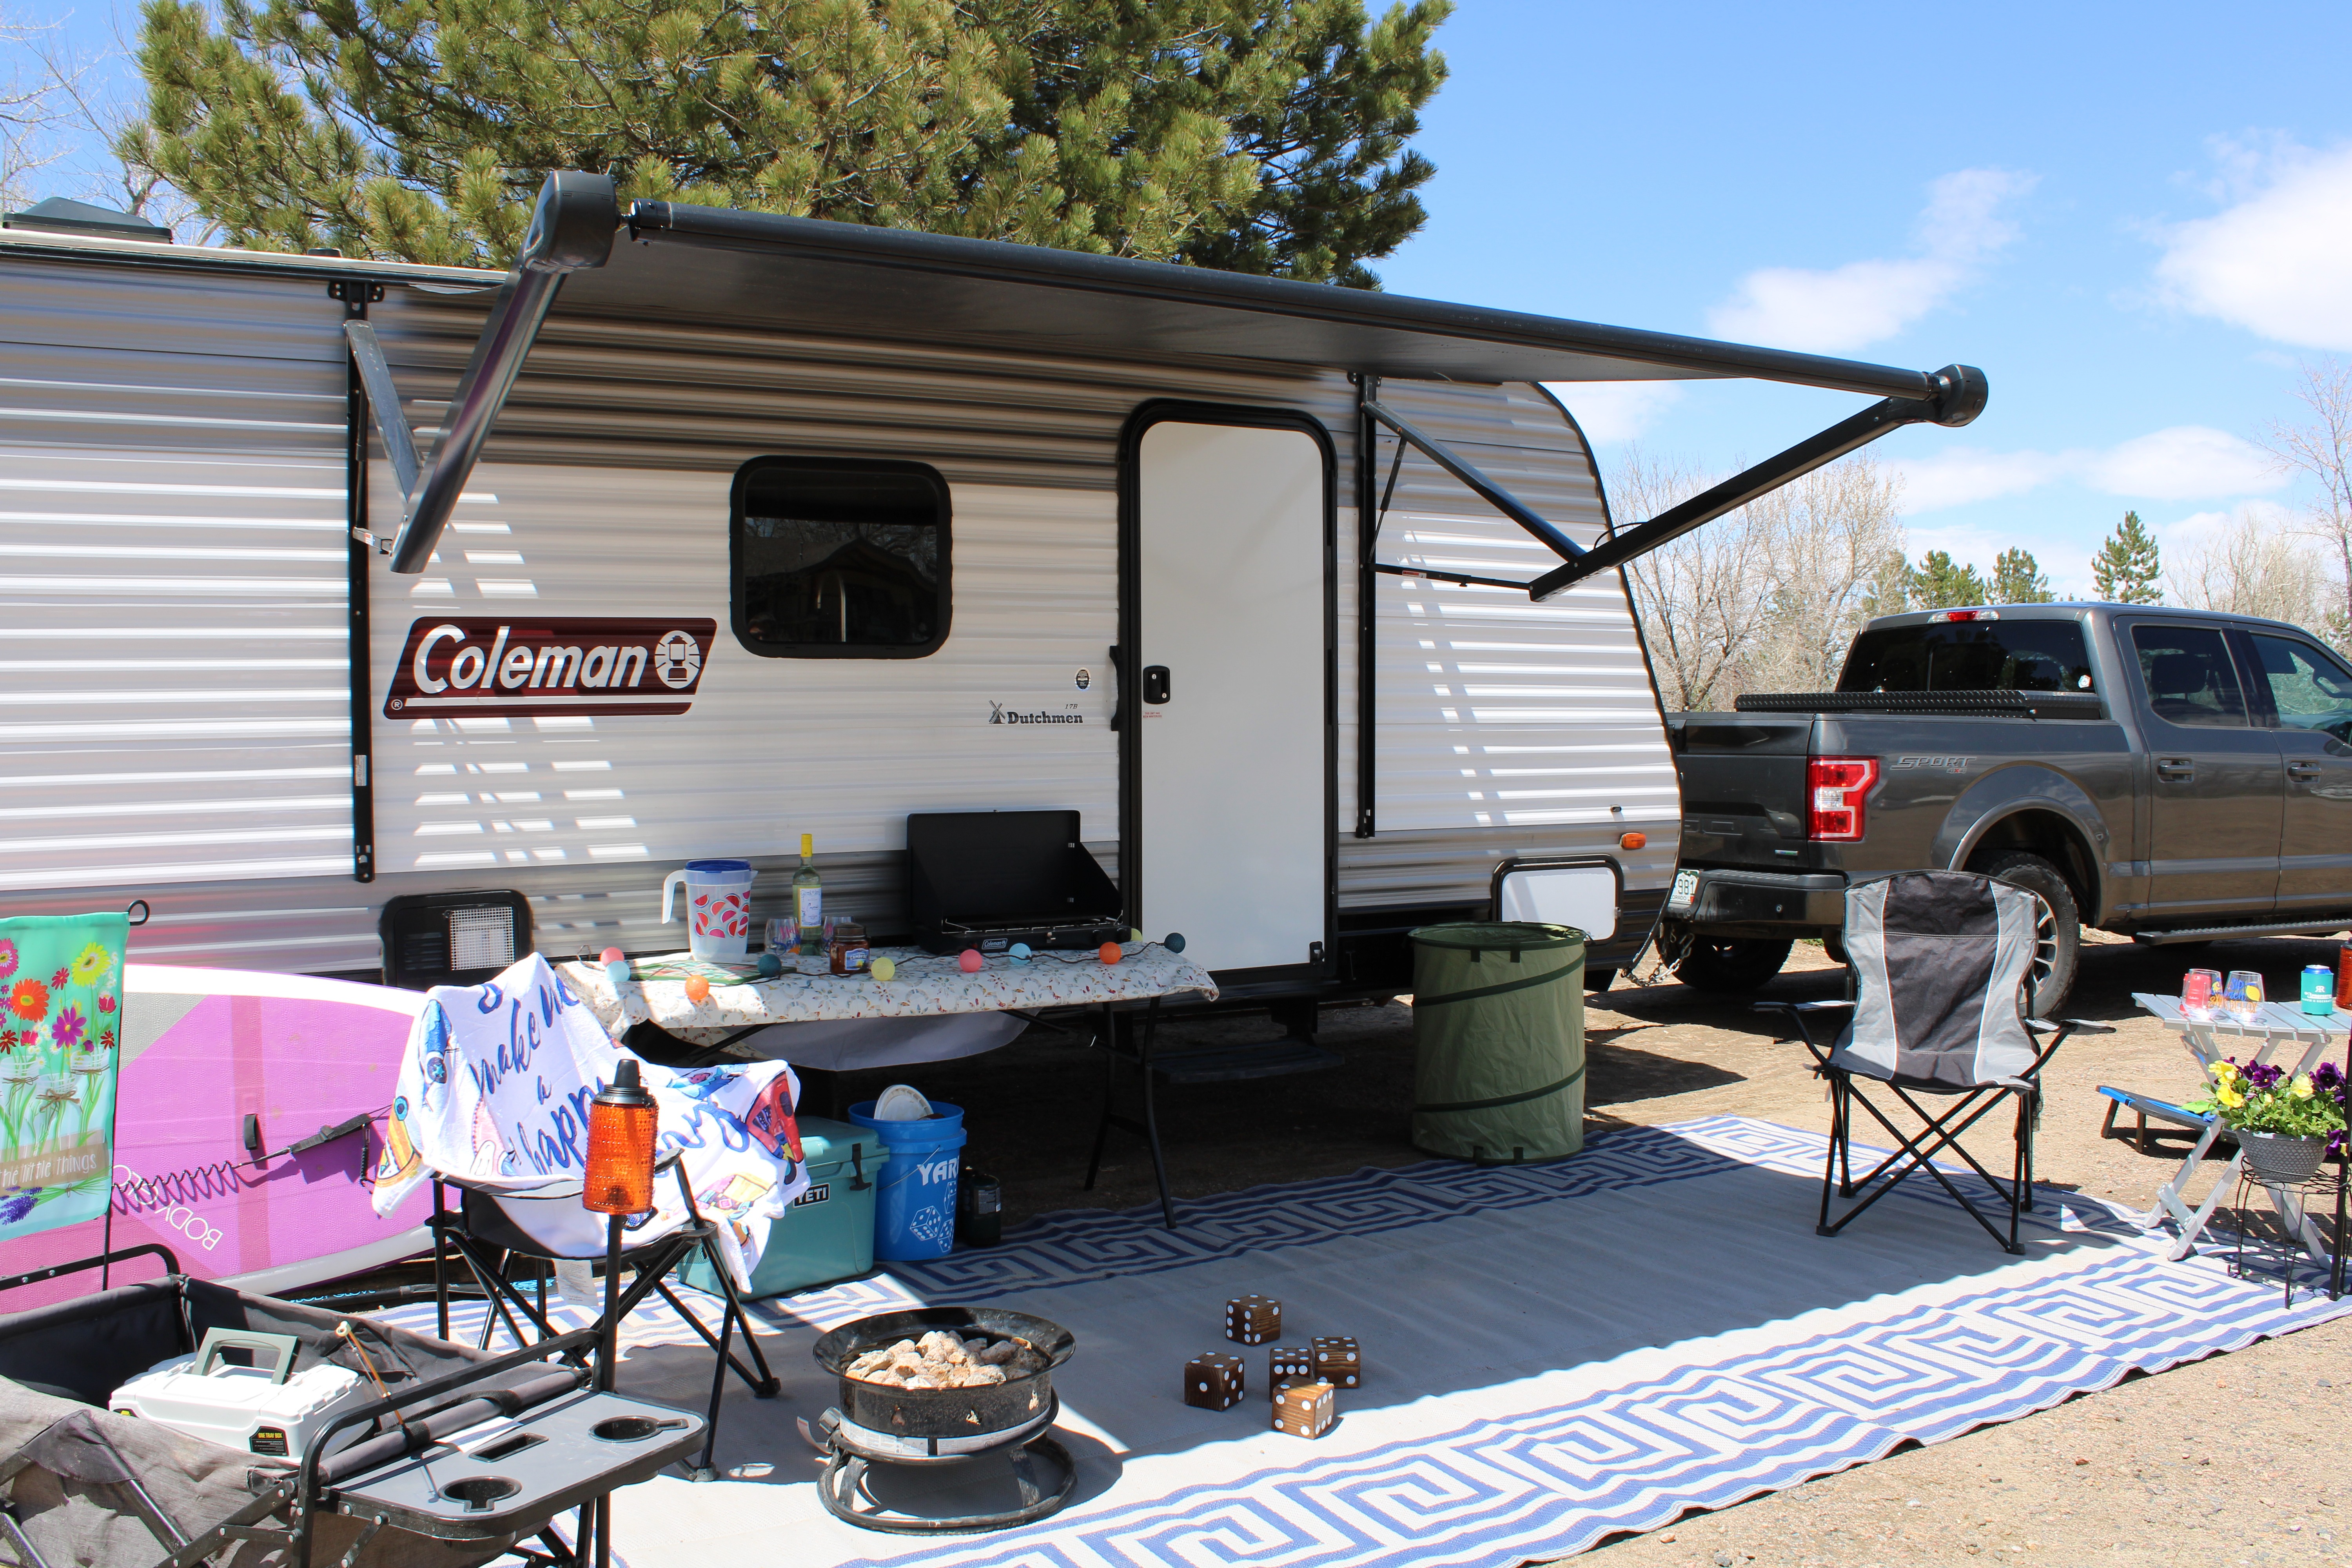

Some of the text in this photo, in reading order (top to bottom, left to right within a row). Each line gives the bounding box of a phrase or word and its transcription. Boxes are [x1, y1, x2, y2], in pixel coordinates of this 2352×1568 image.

[414, 624, 648, 694] Coleman
[1008, 711, 1083, 724] Dutchmen
[1890, 756, 1977, 769] SPORT
[916, 1155, 960, 1186] YAR
[797, 1187, 827, 1204] YETI
[154, 1199, 224, 1251] BODY
